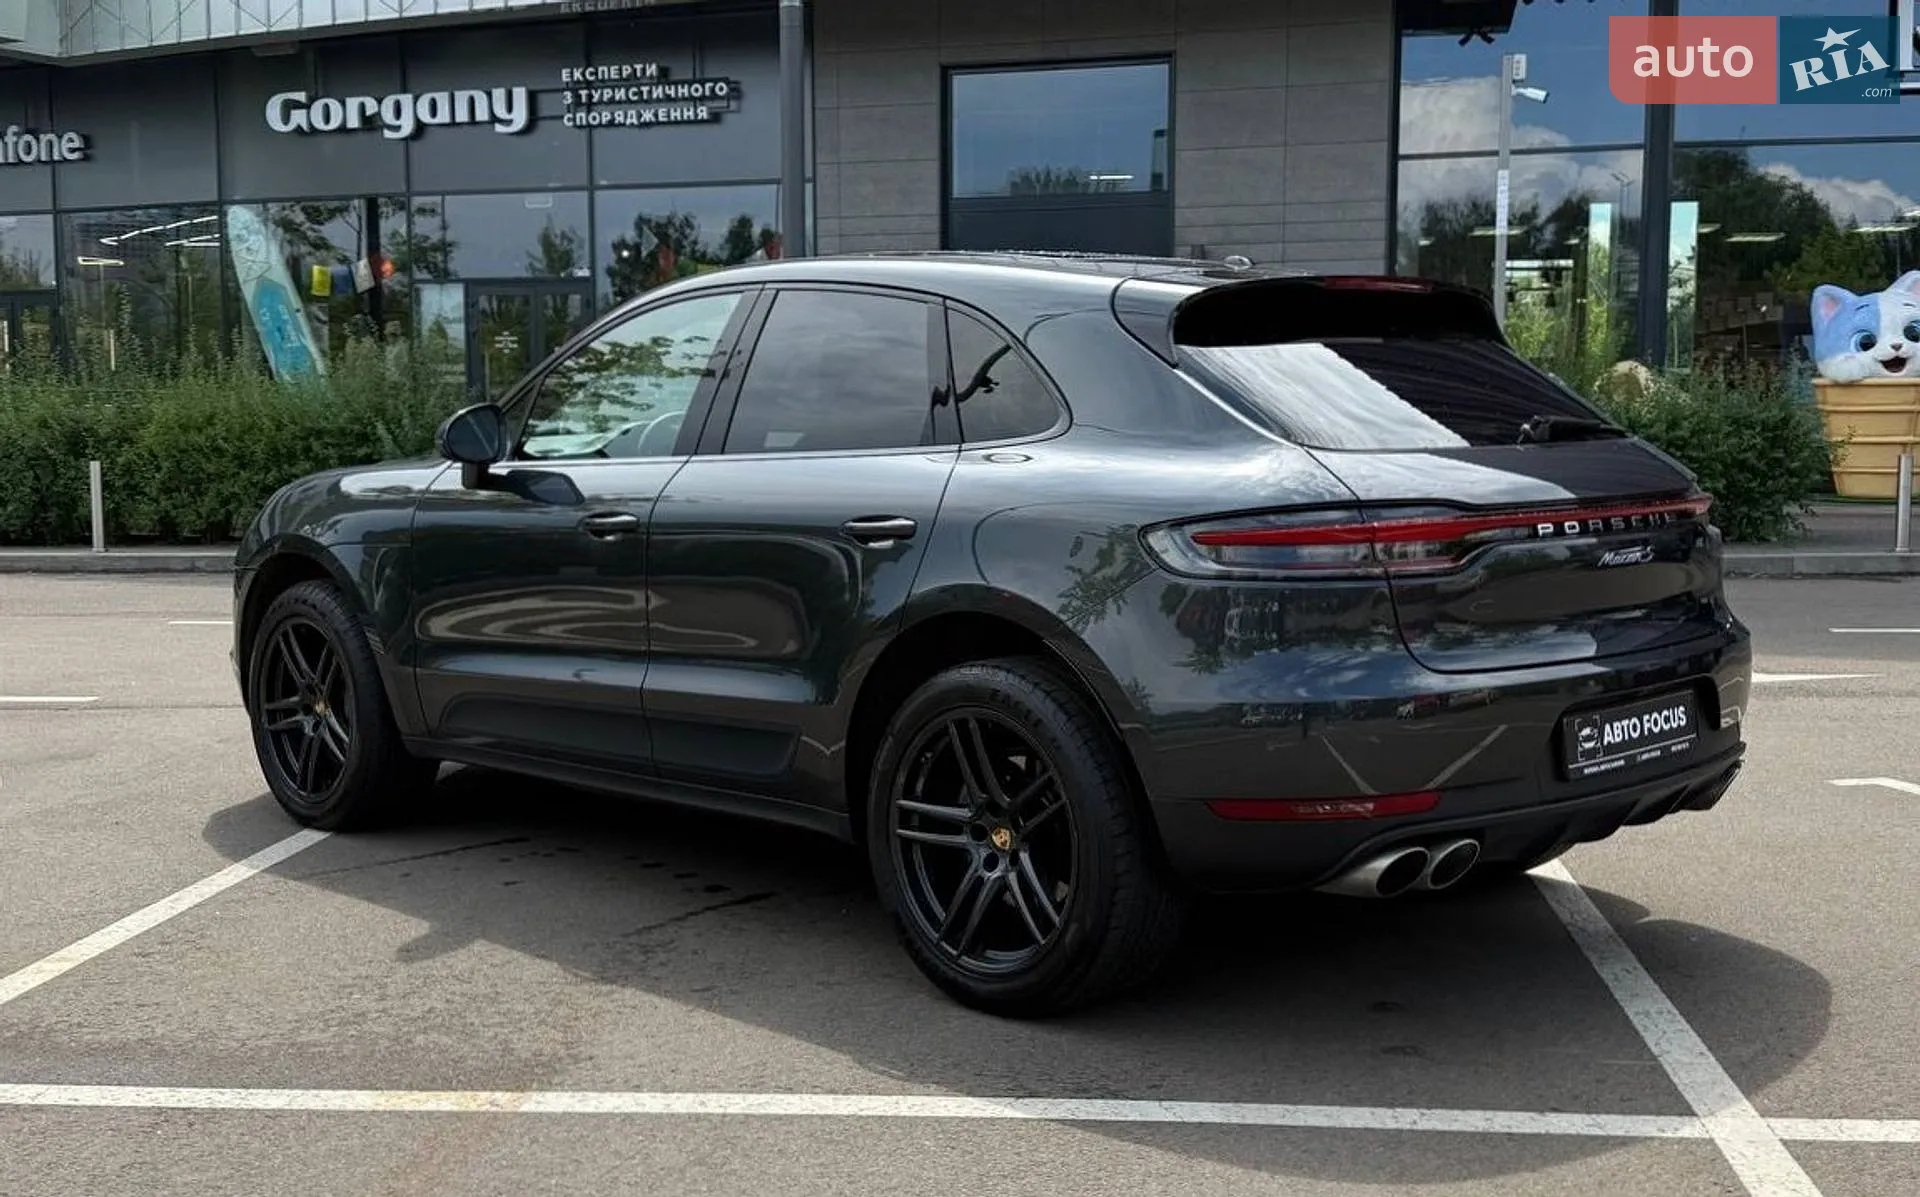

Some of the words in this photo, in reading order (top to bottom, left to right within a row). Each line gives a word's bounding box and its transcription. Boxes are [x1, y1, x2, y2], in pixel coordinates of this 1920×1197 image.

[561, 63, 658, 82] ЕКСПЕРТИ
[579, 81, 728, 104] ТУРИСТИЧНОГО
[265, 87, 529, 139] Gorgany
[563, 106, 709, 127] СПОРЯДЖЕННЯ
[0, 125, 84, 164] fone
[1643, 705, 1688, 736] FOCUS
